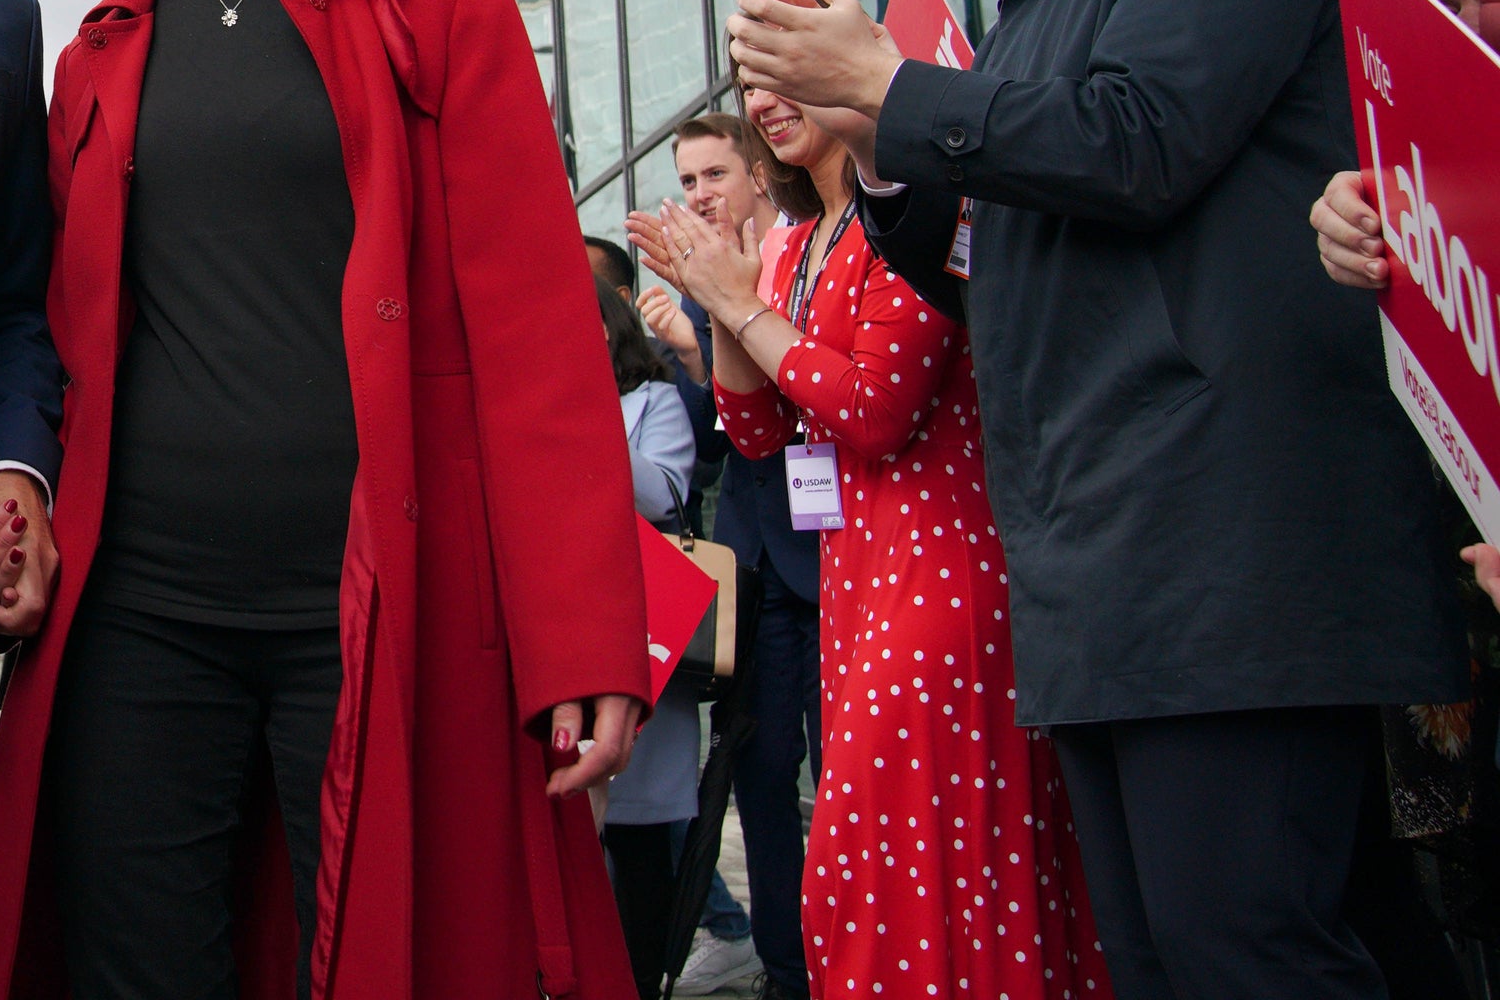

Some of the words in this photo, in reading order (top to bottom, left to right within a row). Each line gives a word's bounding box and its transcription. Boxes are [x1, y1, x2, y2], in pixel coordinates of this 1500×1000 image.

[1356, 25, 1394, 106] Vote
[1365, 98, 1500, 408] Labou
[804, 478, 831, 487] USDAW
